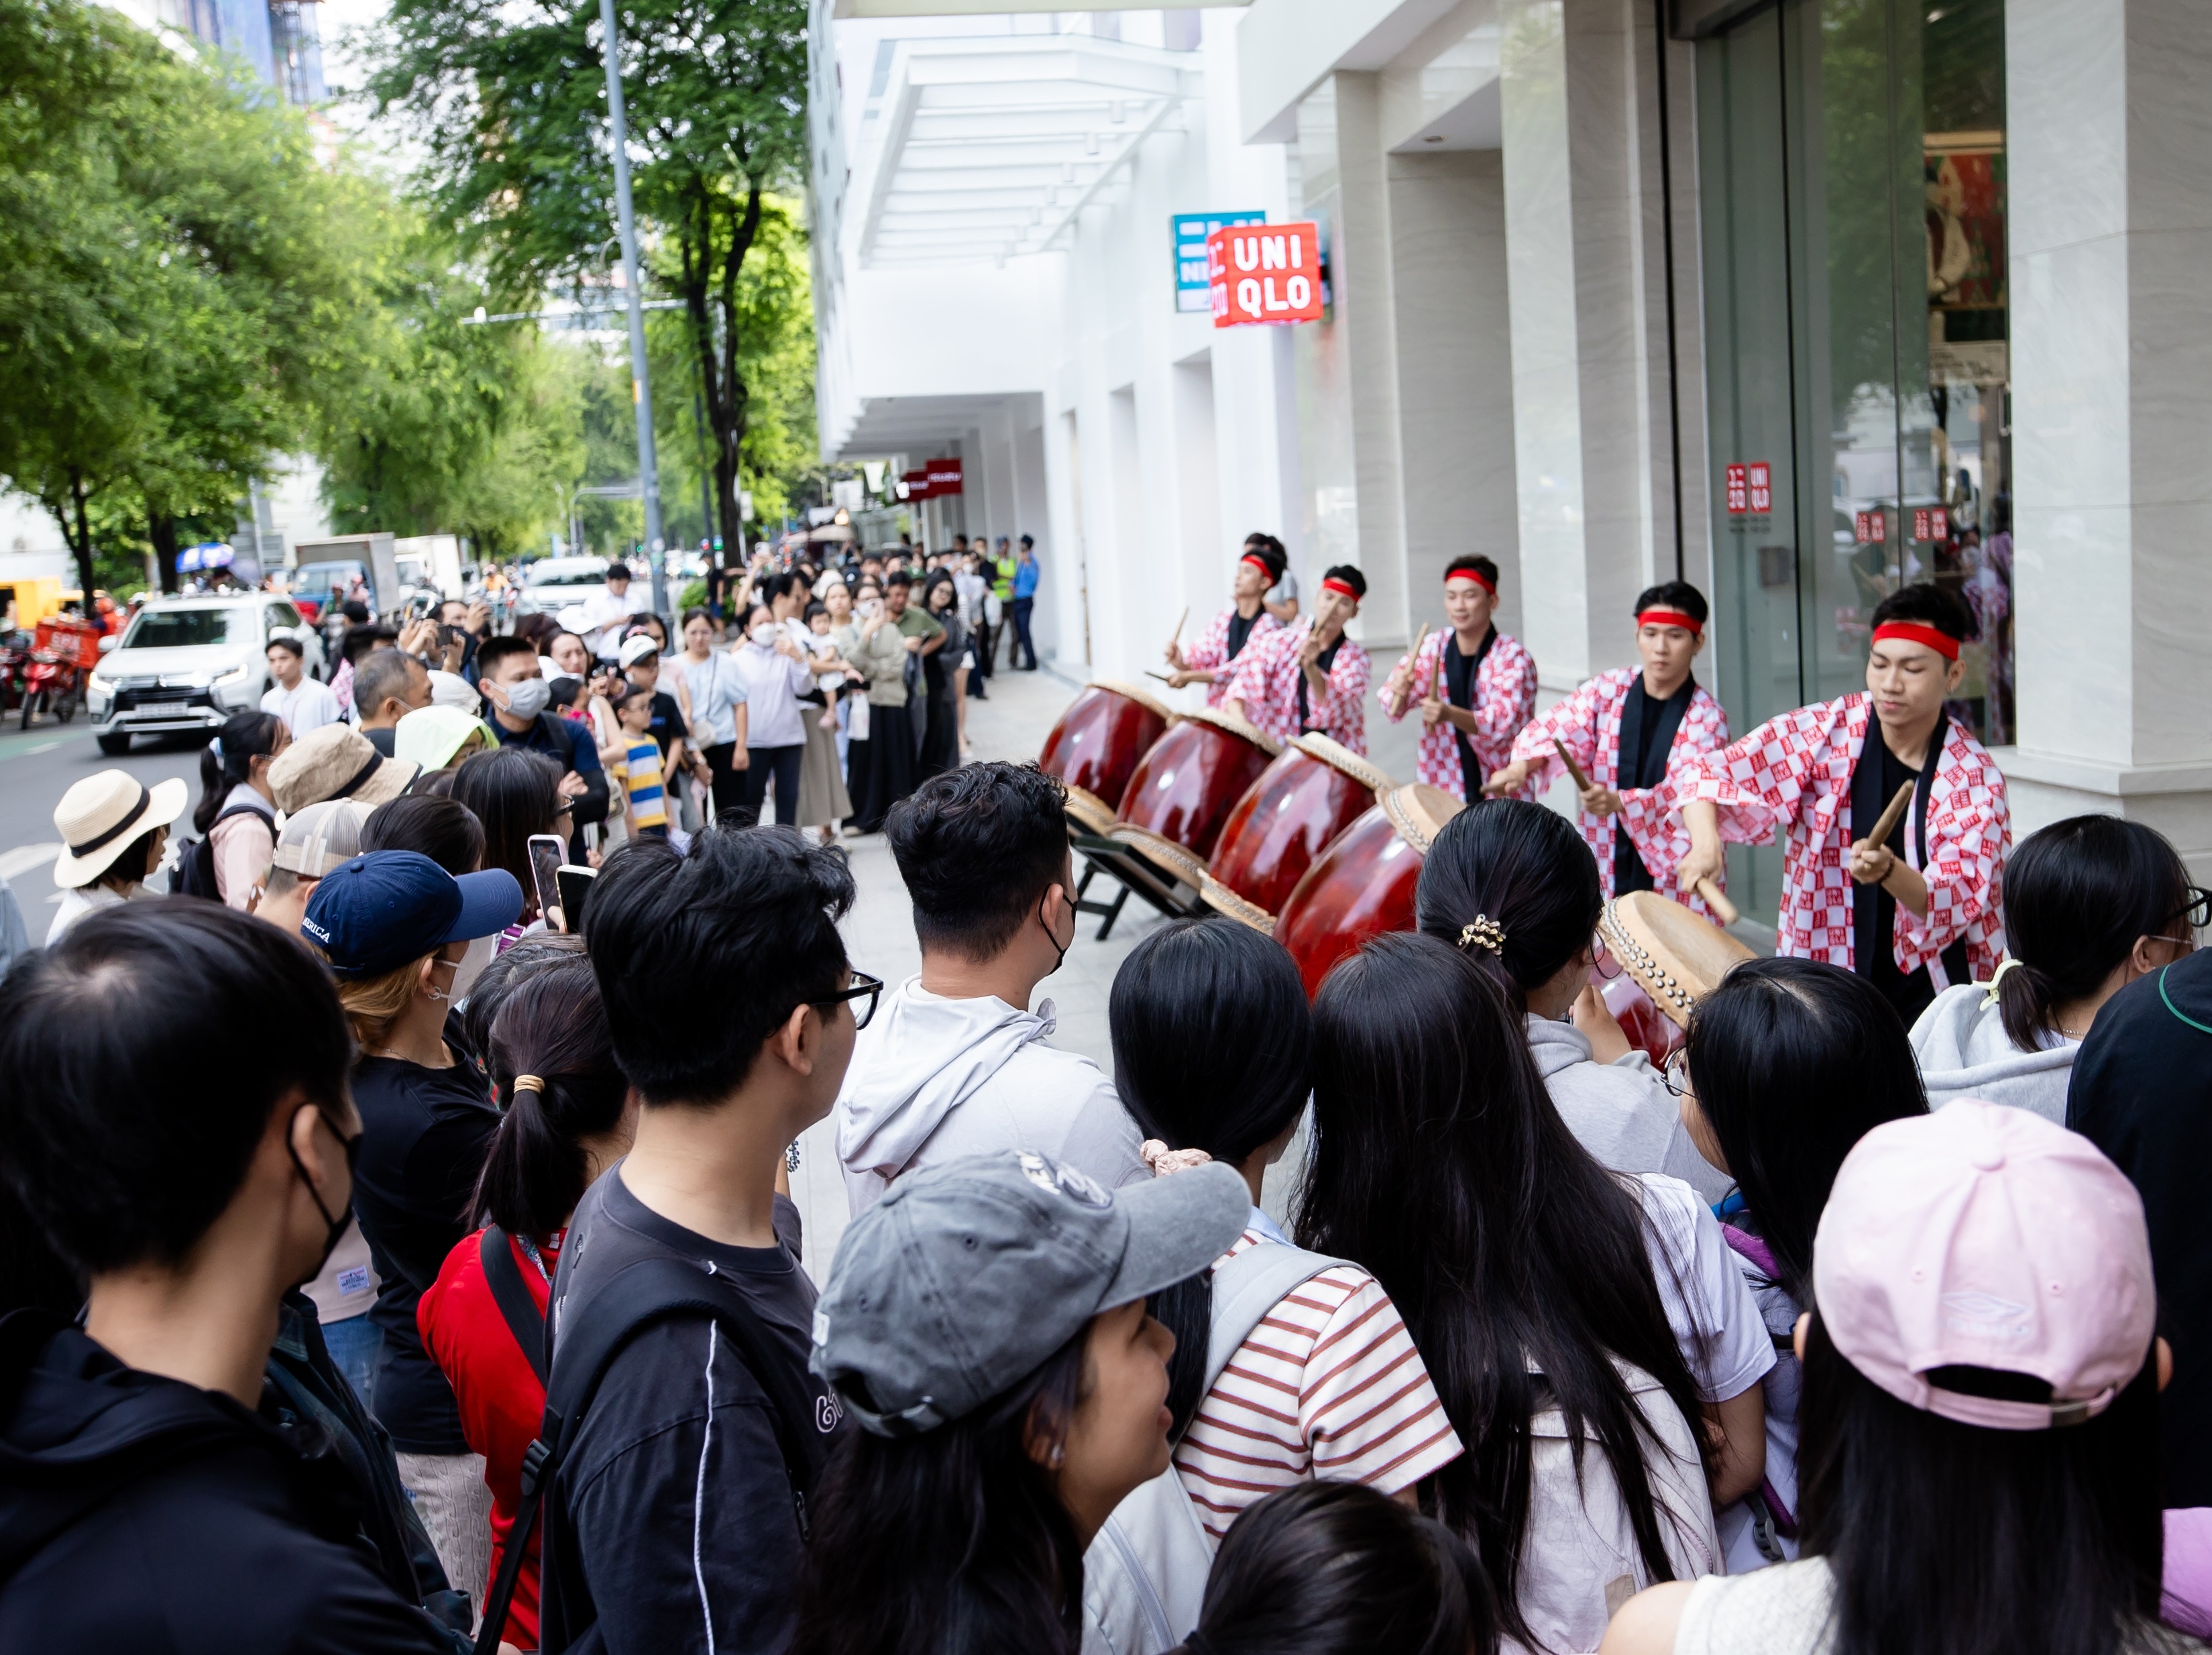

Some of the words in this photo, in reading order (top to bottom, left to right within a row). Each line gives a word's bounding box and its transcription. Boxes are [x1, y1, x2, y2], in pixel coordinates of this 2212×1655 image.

[1233, 233, 1303, 272] UNI
[1237, 275, 1311, 319] QLO
[1750, 467, 1767, 488] UNI
[1752, 488, 1769, 511] QLO
